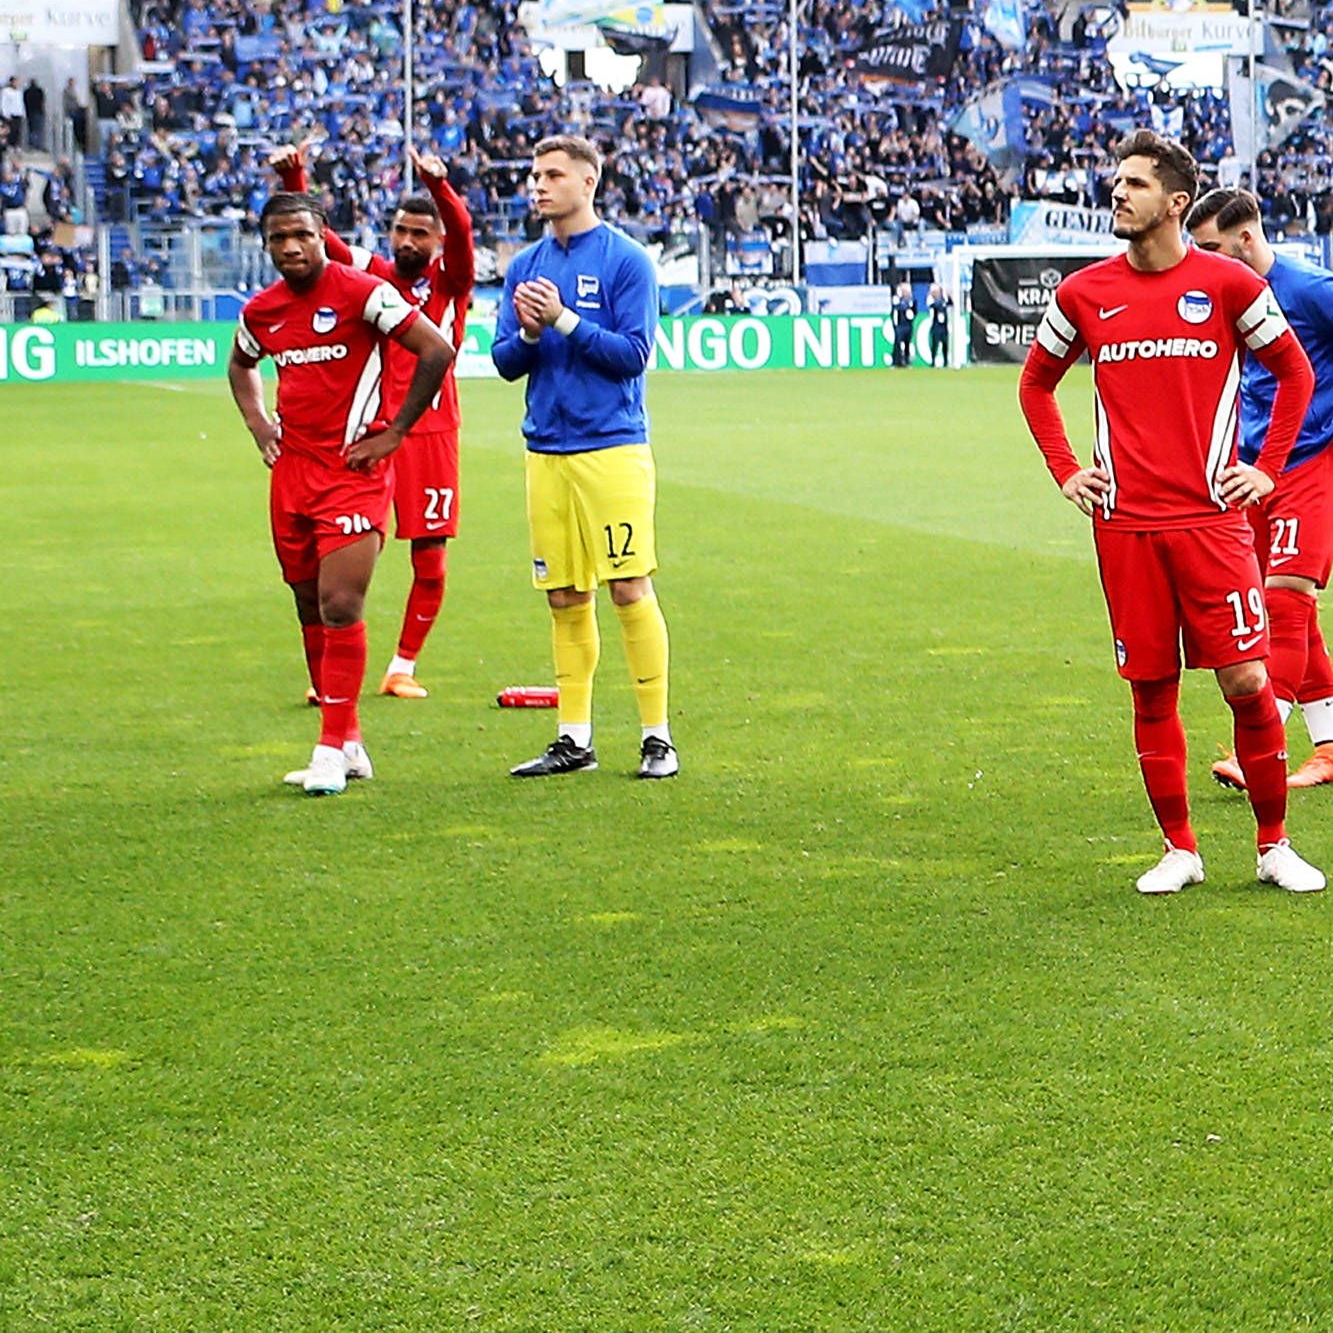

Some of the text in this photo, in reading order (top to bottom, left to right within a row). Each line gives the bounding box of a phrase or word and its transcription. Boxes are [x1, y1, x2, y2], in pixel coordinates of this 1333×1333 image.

[650, 318, 771, 369] NGO
[985, 322, 1036, 346] SPIE
[1097, 337, 1218, 363] AUTOHERO
[76, 338, 216, 367] ILSHOFEN
[424, 487, 454, 520] 27
[604, 522, 636, 559] 12
[1270, 517, 1300, 555] 21
[1226, 587, 1265, 637] 19
